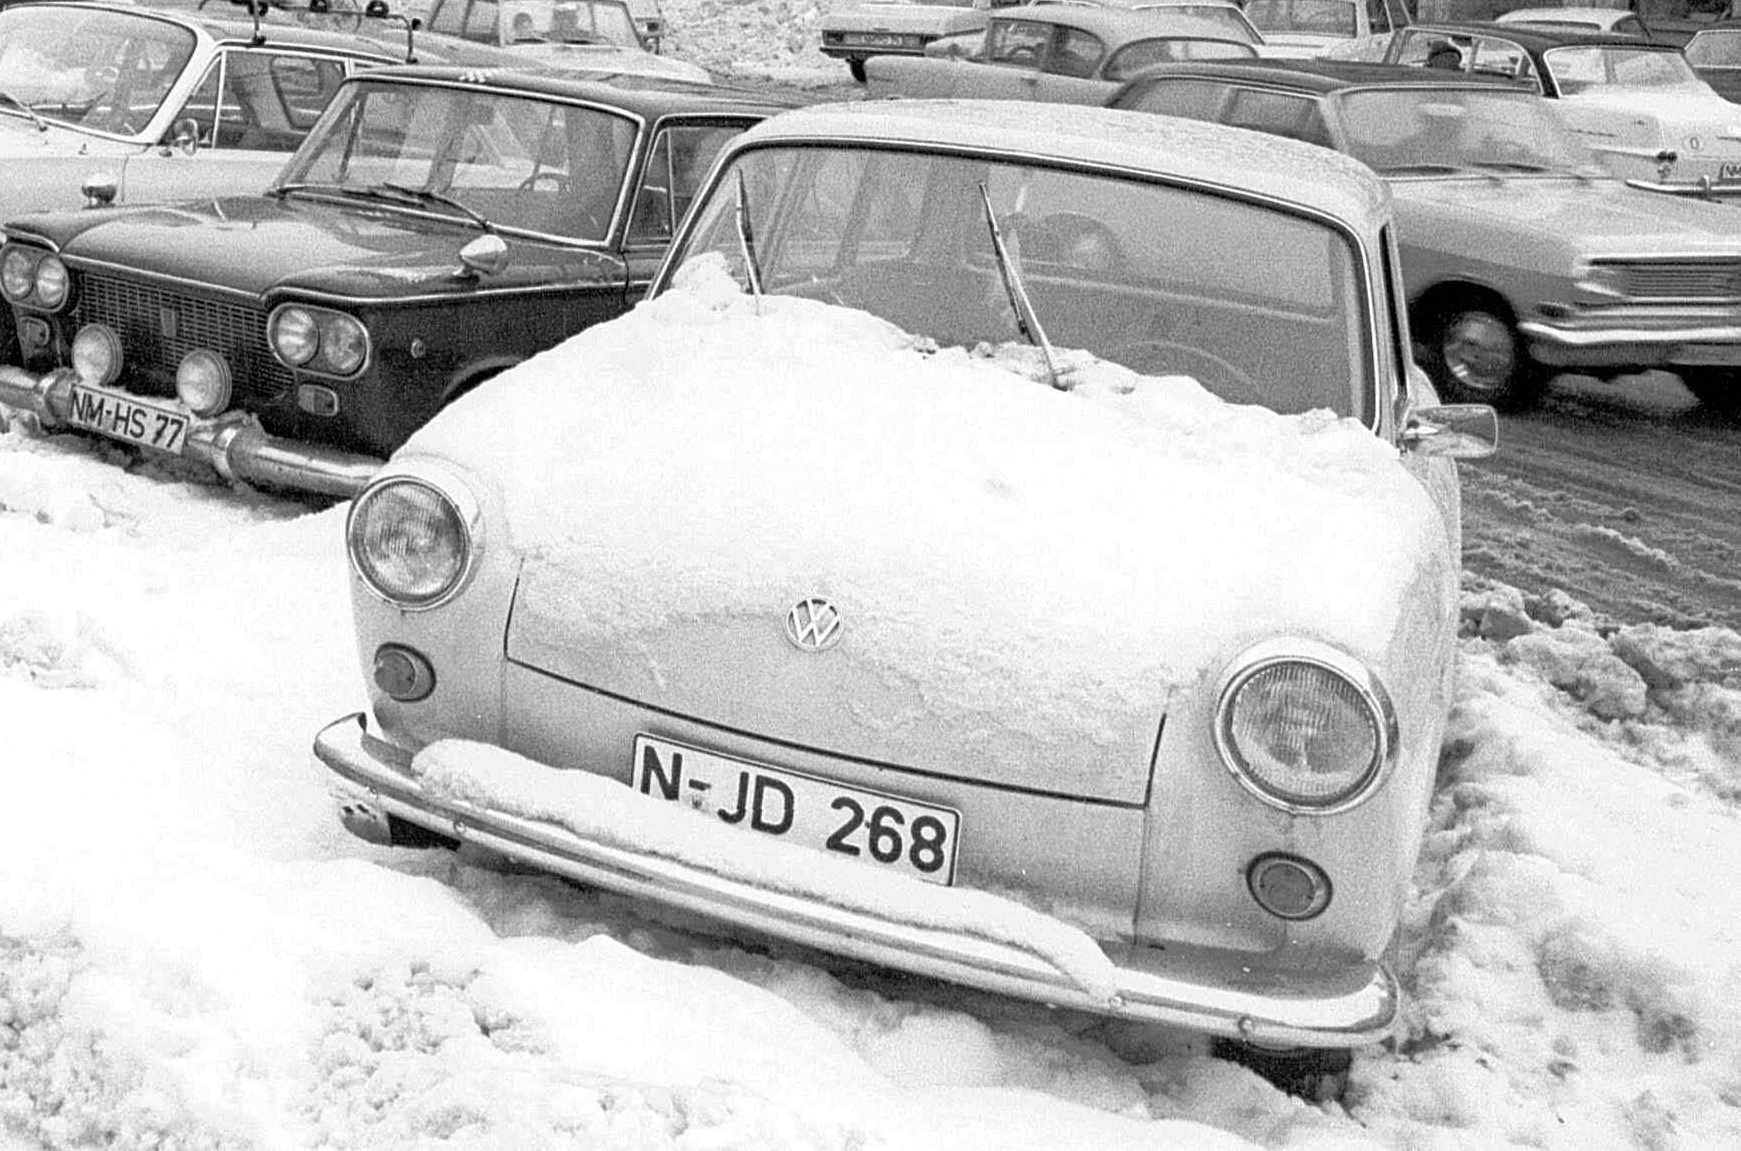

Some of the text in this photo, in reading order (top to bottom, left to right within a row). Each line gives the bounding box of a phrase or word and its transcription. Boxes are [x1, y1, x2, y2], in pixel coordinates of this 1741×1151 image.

[71, 389, 186, 450] NM-HS 77
[785, 597, 844, 649] VW
[639, 744, 949, 874] N-JD 268
